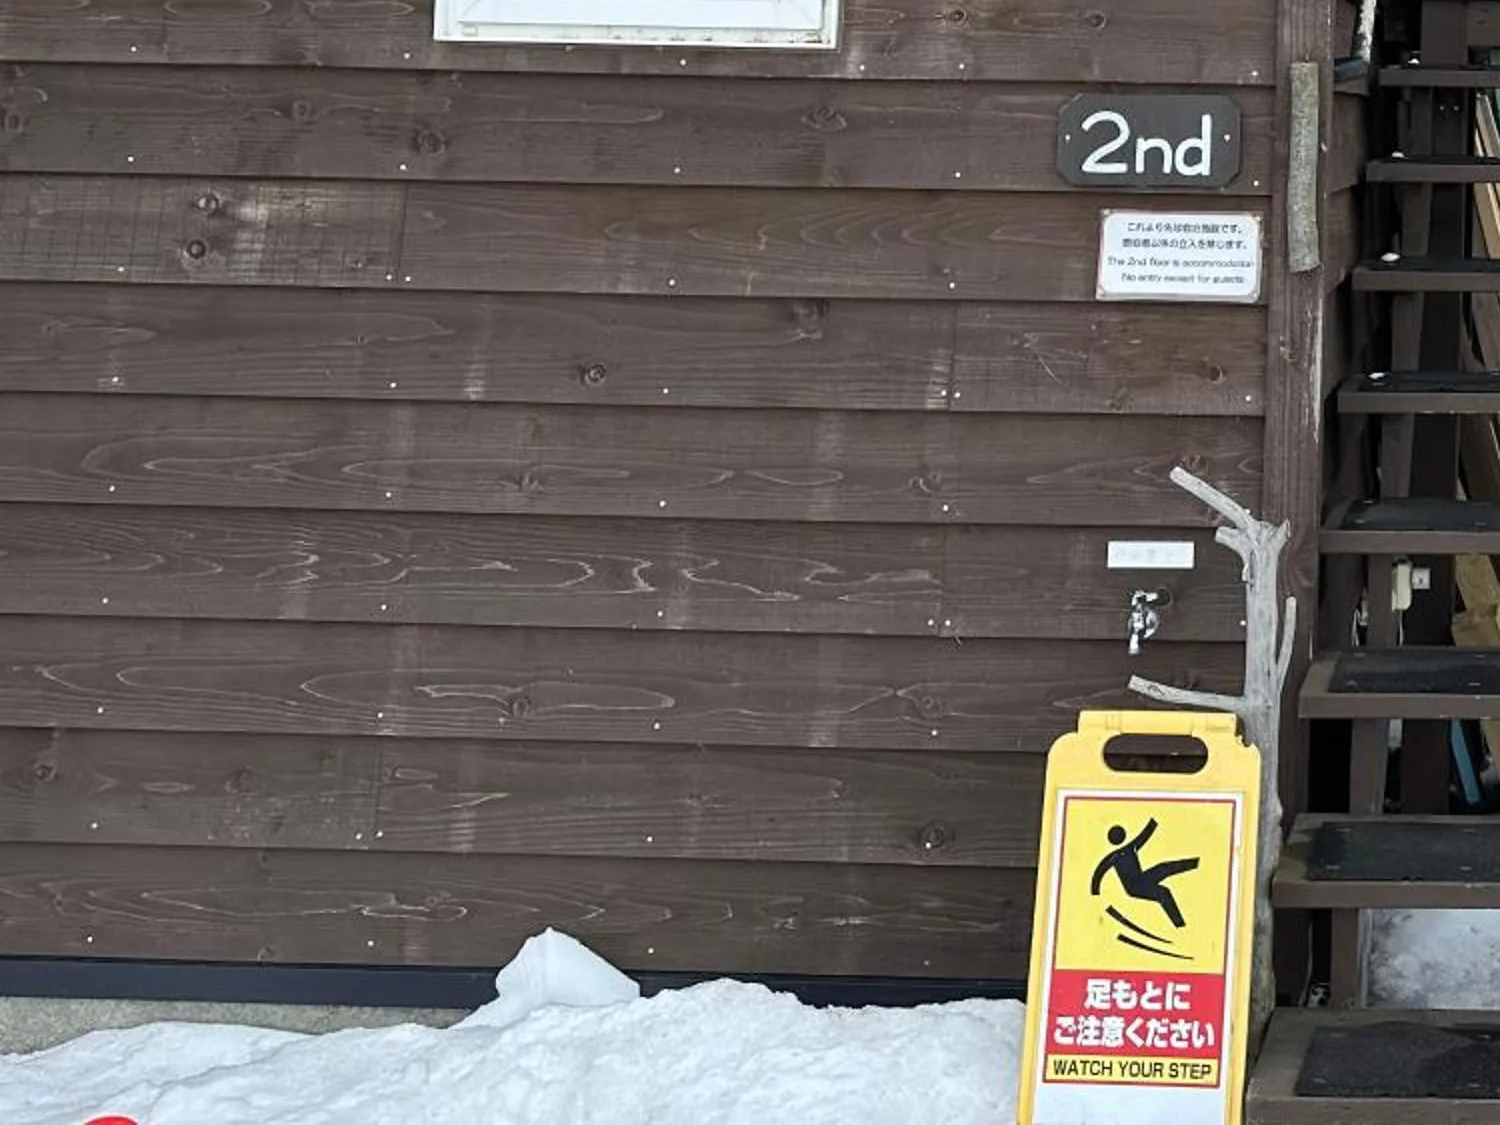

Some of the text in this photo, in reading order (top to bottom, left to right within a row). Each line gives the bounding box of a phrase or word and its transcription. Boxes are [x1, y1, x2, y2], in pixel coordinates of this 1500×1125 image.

[1081, 110, 1211, 176] 2nd
[1084, 978, 1191, 1011] 足もとに
[1053, 1015, 1215, 1048] ご注意ください
[1053, 1060, 1212, 1079] WATCH YOUR STEP
